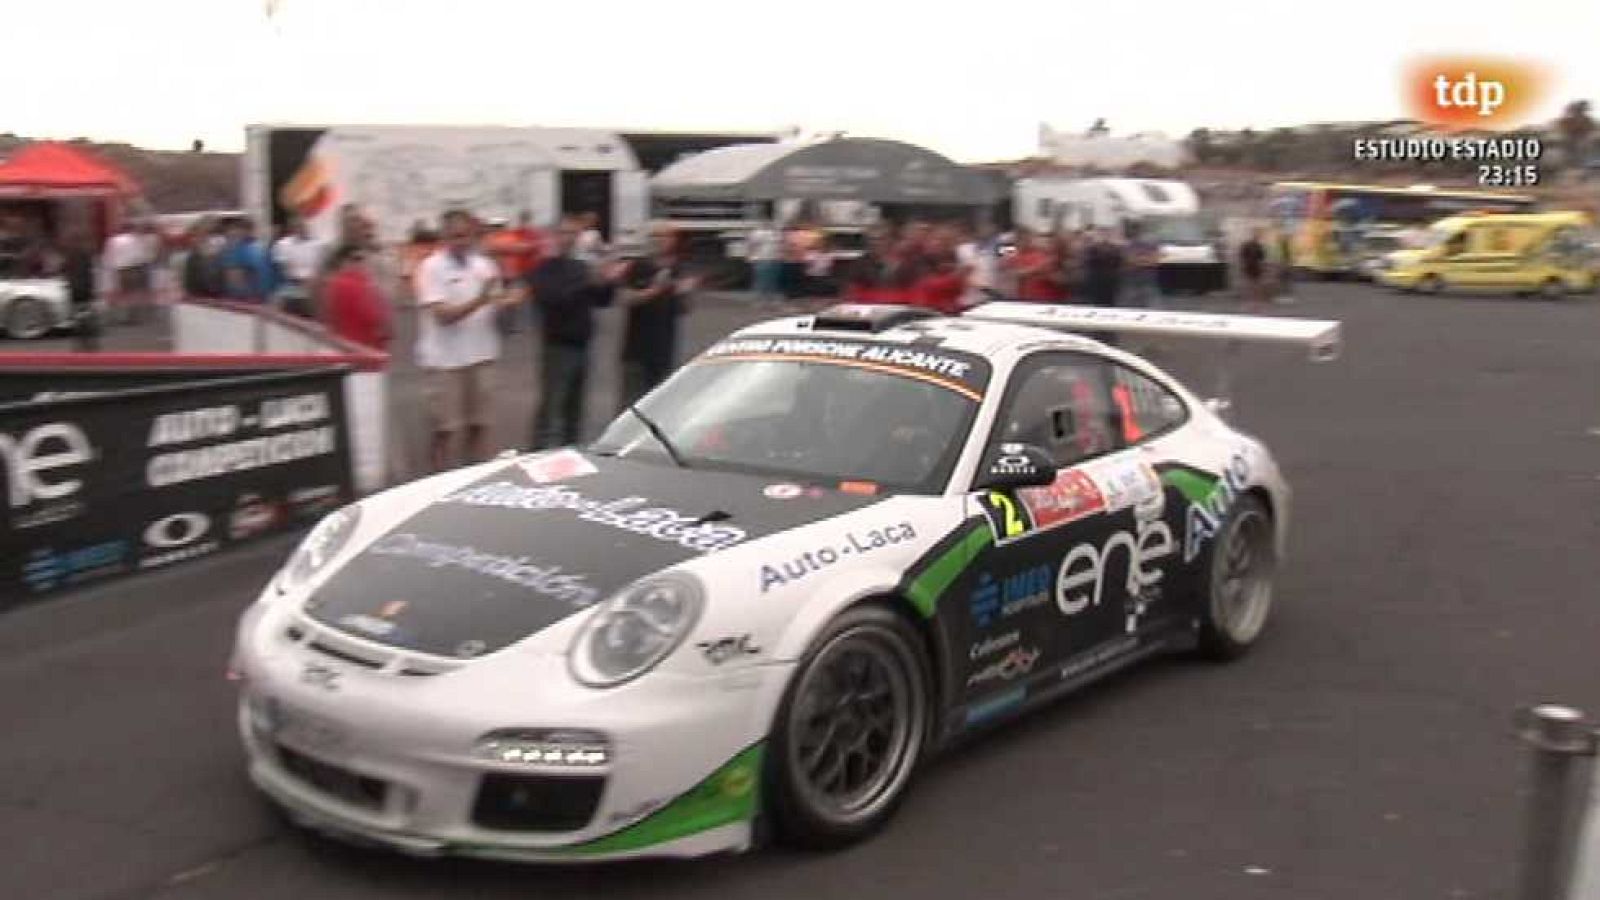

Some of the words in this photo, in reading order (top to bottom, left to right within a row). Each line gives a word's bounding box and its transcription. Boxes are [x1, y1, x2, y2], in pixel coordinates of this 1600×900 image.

[859, 345, 969, 379] ALICANTE
[990, 491, 1025, 538] 2
[760, 520, 917, 593] Auto-Laca
[1056, 520, 1174, 615] ene
